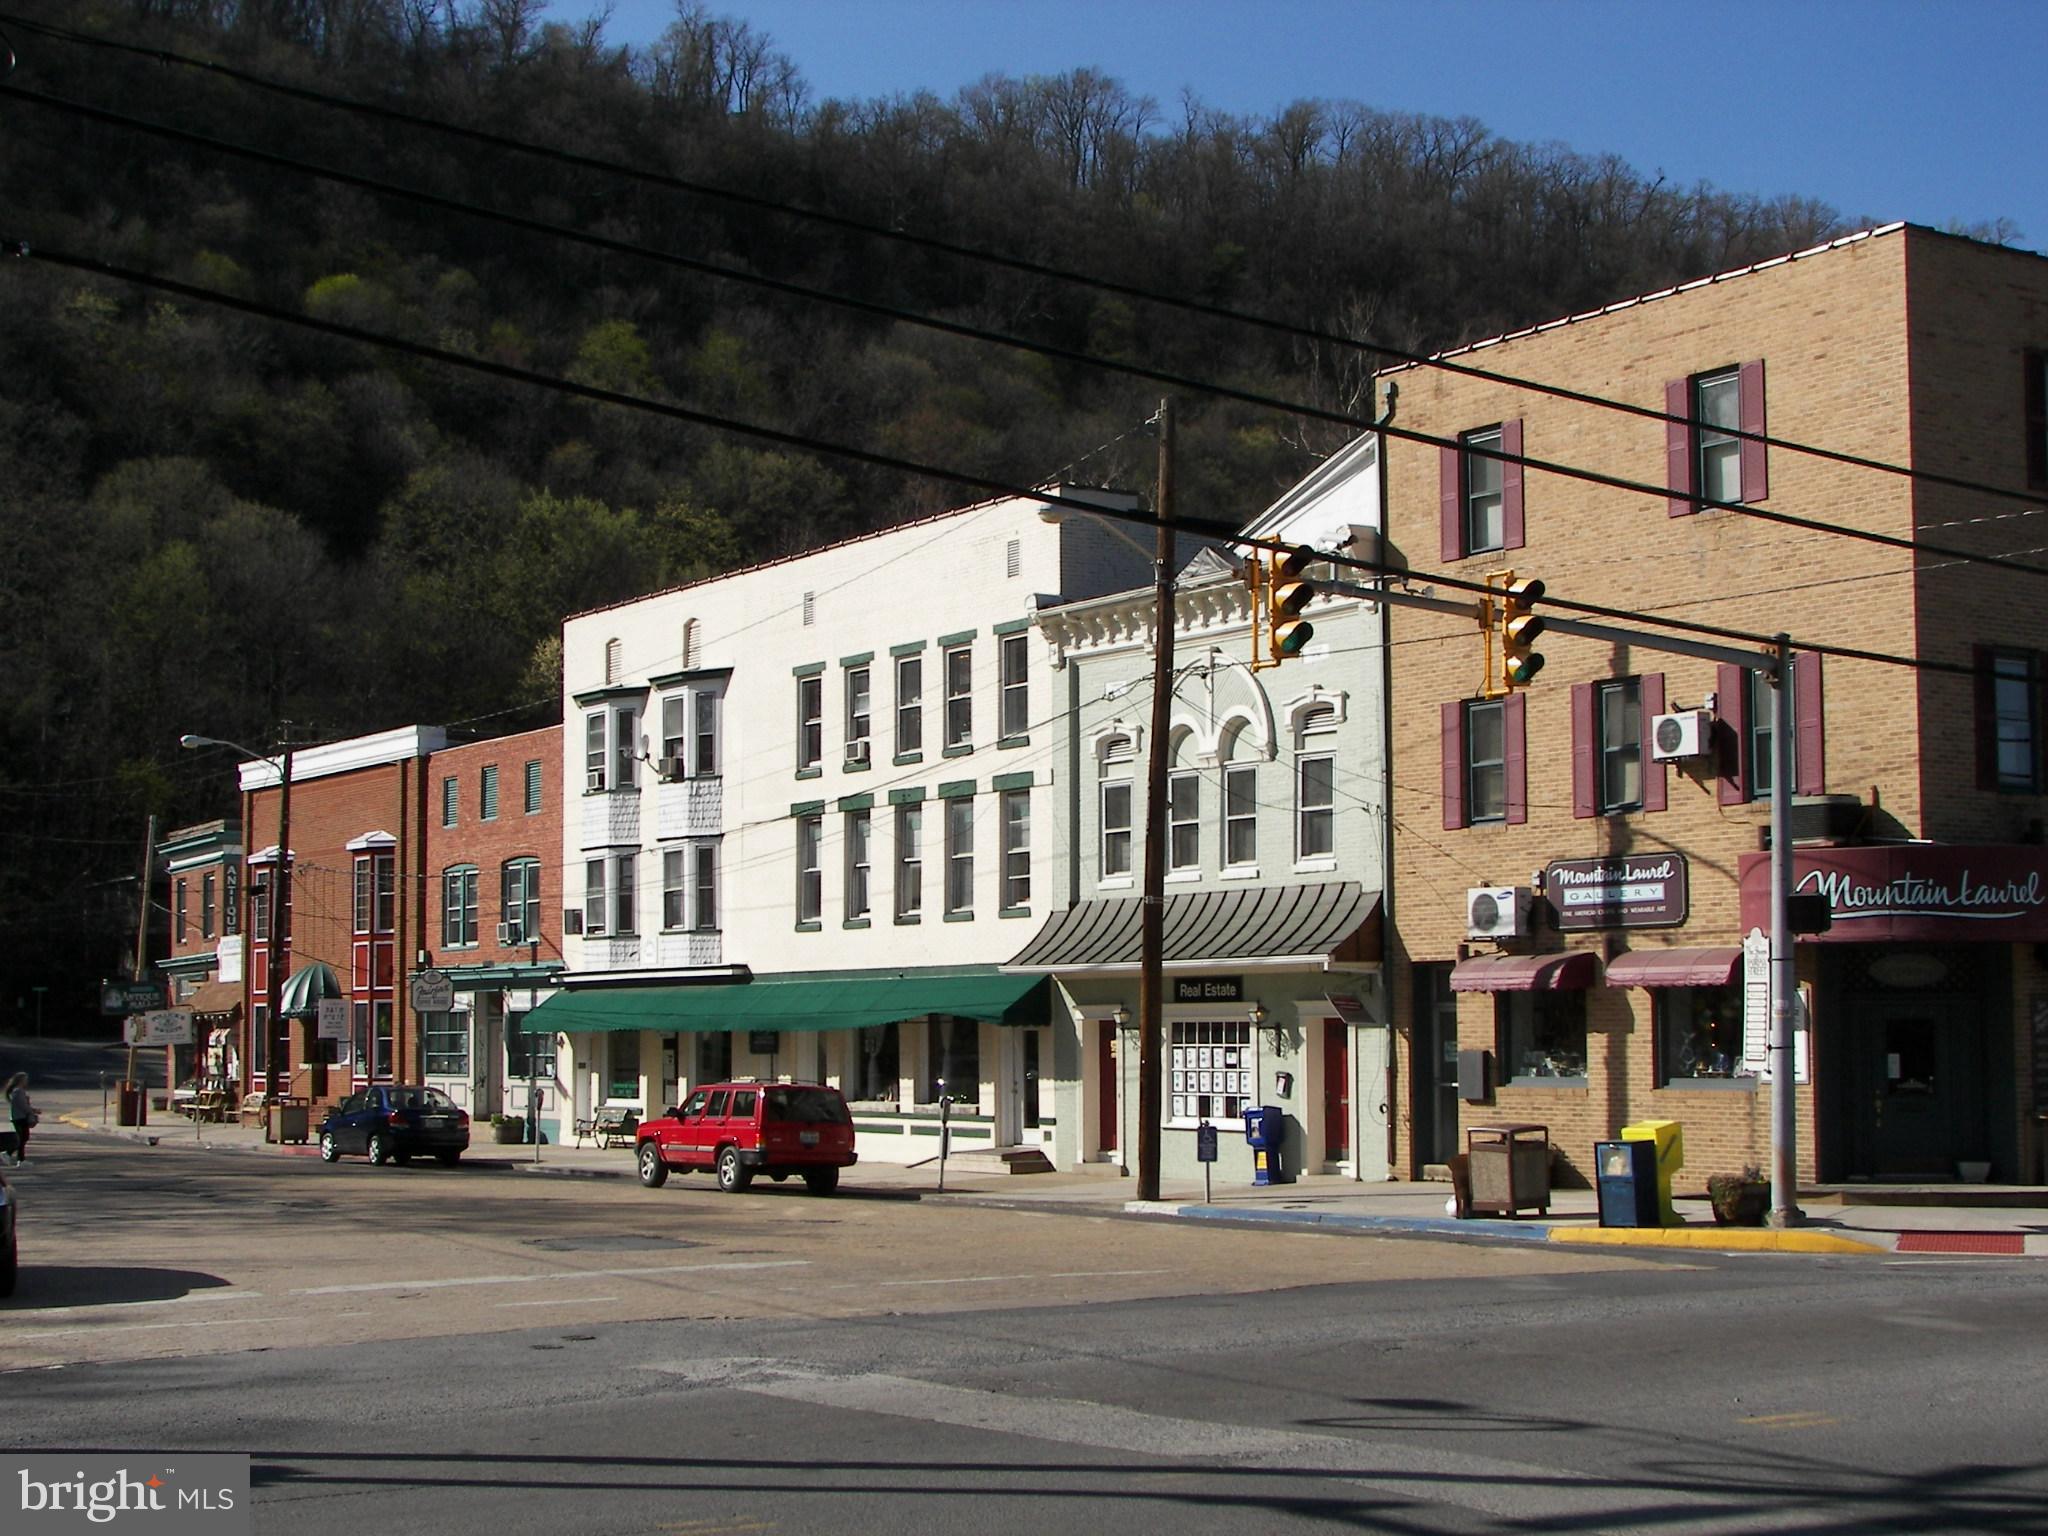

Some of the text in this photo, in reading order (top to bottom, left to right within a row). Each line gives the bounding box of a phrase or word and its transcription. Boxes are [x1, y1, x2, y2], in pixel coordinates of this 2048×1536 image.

[1552, 860, 1675, 886] Mountain Laurel
[1569, 887, 1659, 901] GALLERY
[1795, 869, 2046, 908] Mountain Laurel
[1180, 983, 1237, 997] Real Estate
